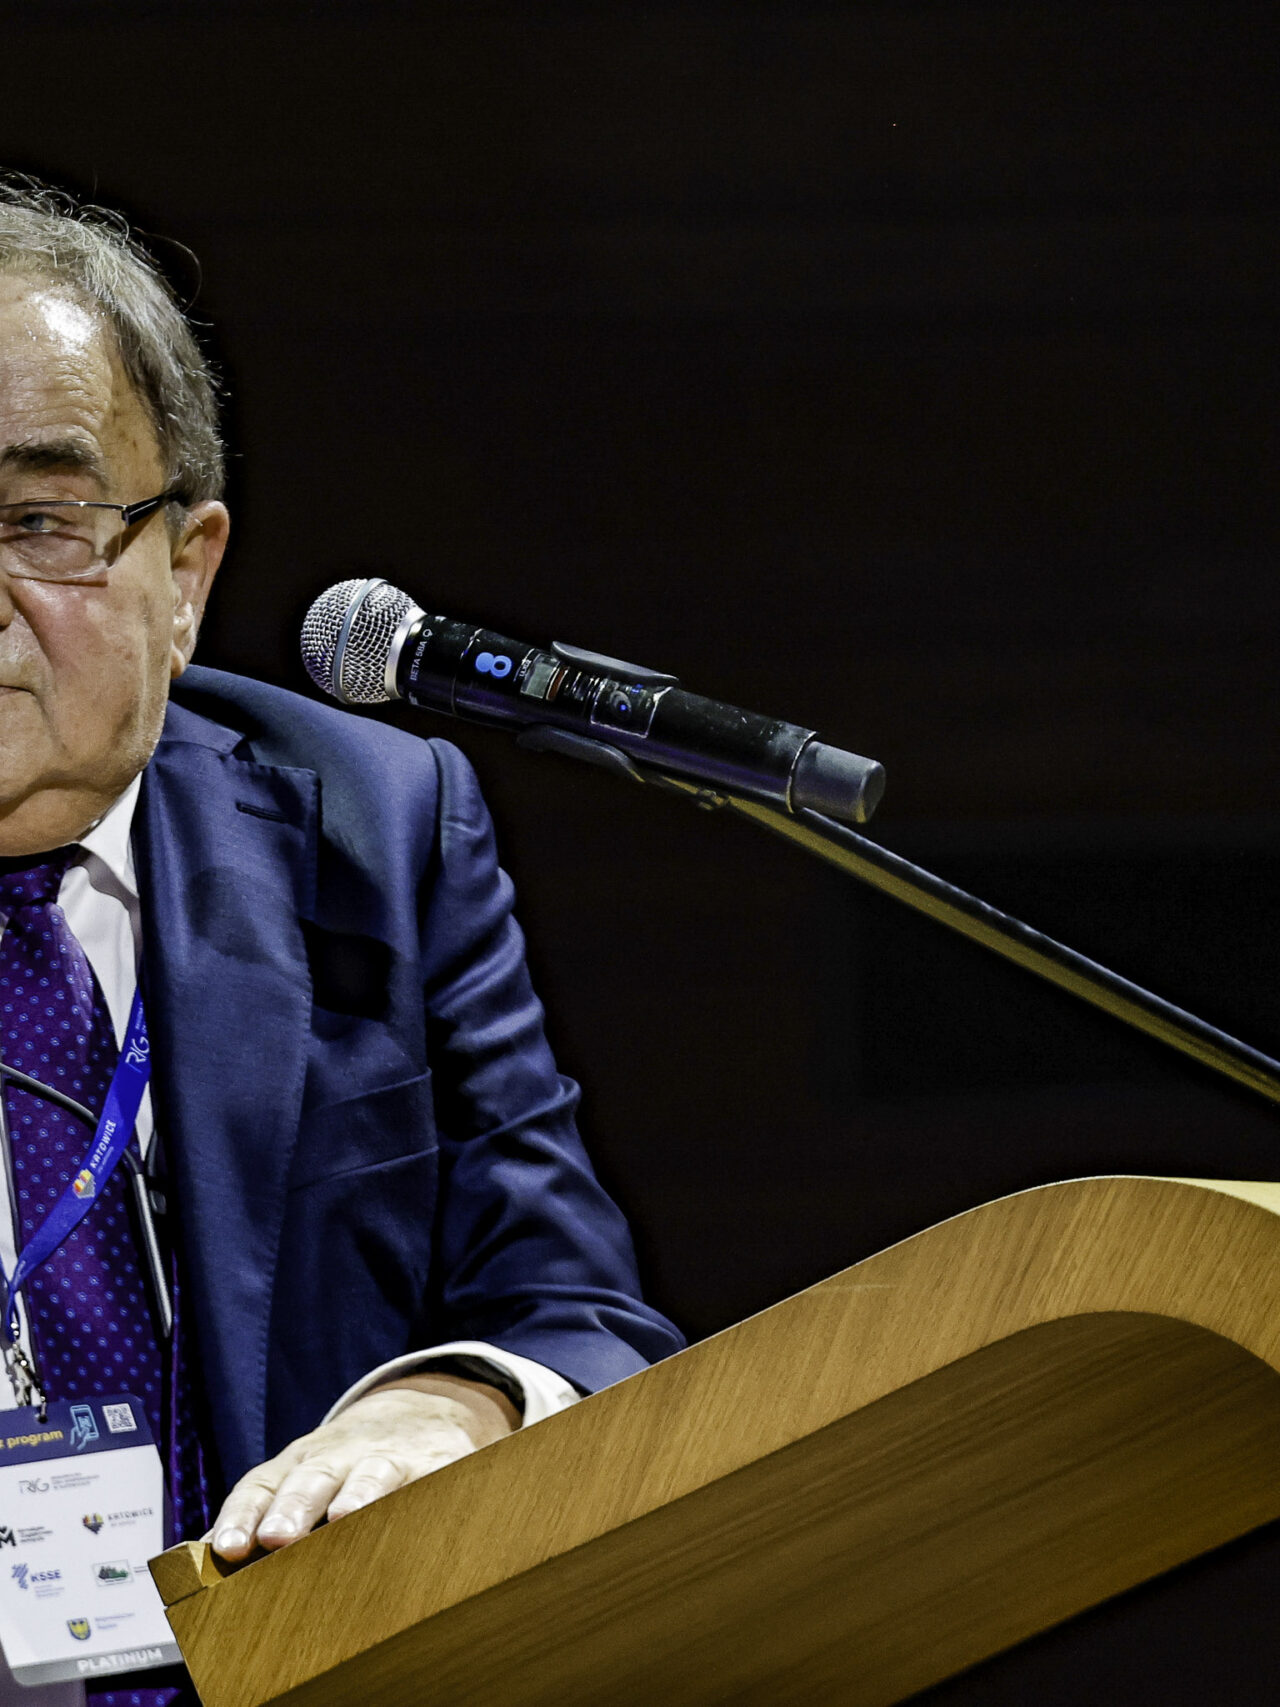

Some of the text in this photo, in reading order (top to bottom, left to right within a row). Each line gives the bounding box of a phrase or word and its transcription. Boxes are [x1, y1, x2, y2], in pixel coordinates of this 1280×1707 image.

[475, 651, 513, 679] 8
[90, 1119, 117, 1169] KATOWICE
[6, 1430, 64, 1449] program
[77, 1647, 163, 1674] PLATINUM
